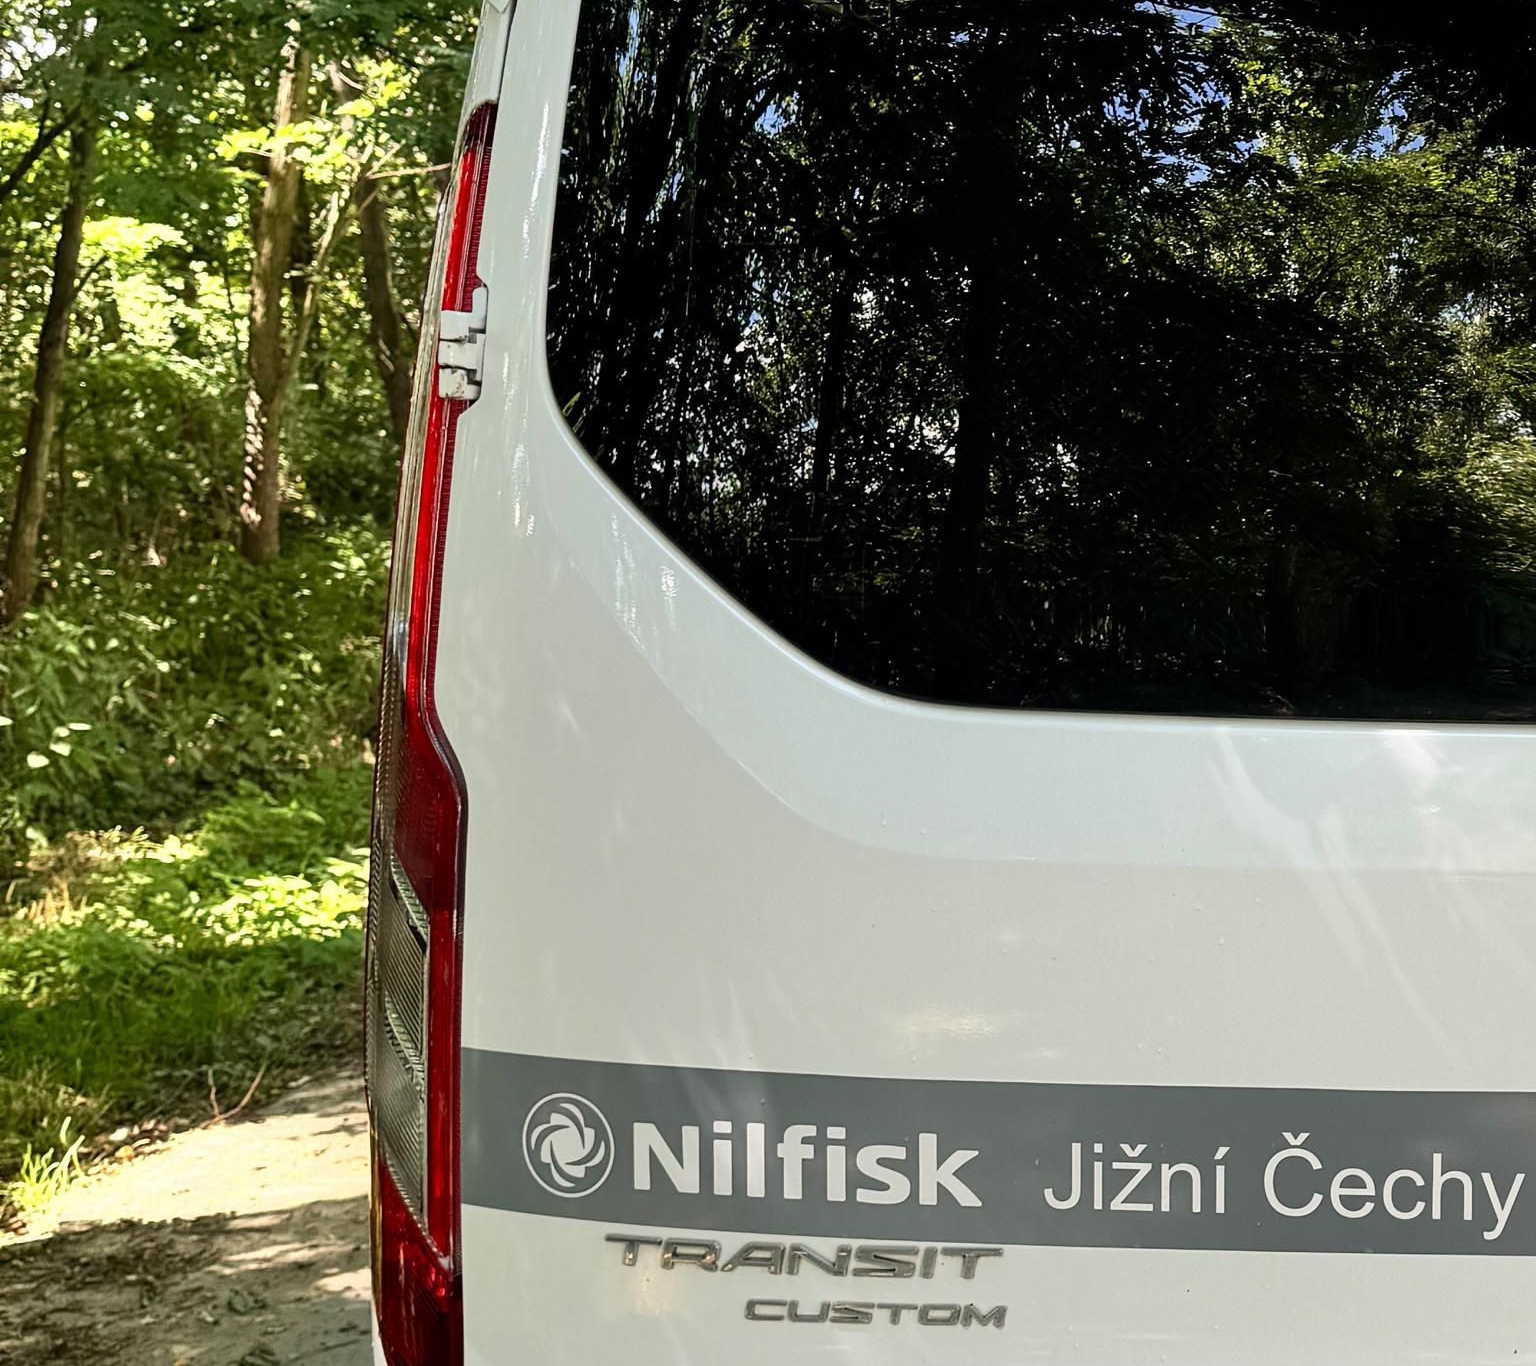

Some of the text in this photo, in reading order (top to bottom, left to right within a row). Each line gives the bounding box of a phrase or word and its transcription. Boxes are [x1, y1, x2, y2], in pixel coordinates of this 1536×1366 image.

[632, 1120, 1527, 1241] Nilfisk Jižní Čechy
[605, 1233, 1004, 1280] TRANSIT
[744, 1298, 1008, 1330] CUSTOM
